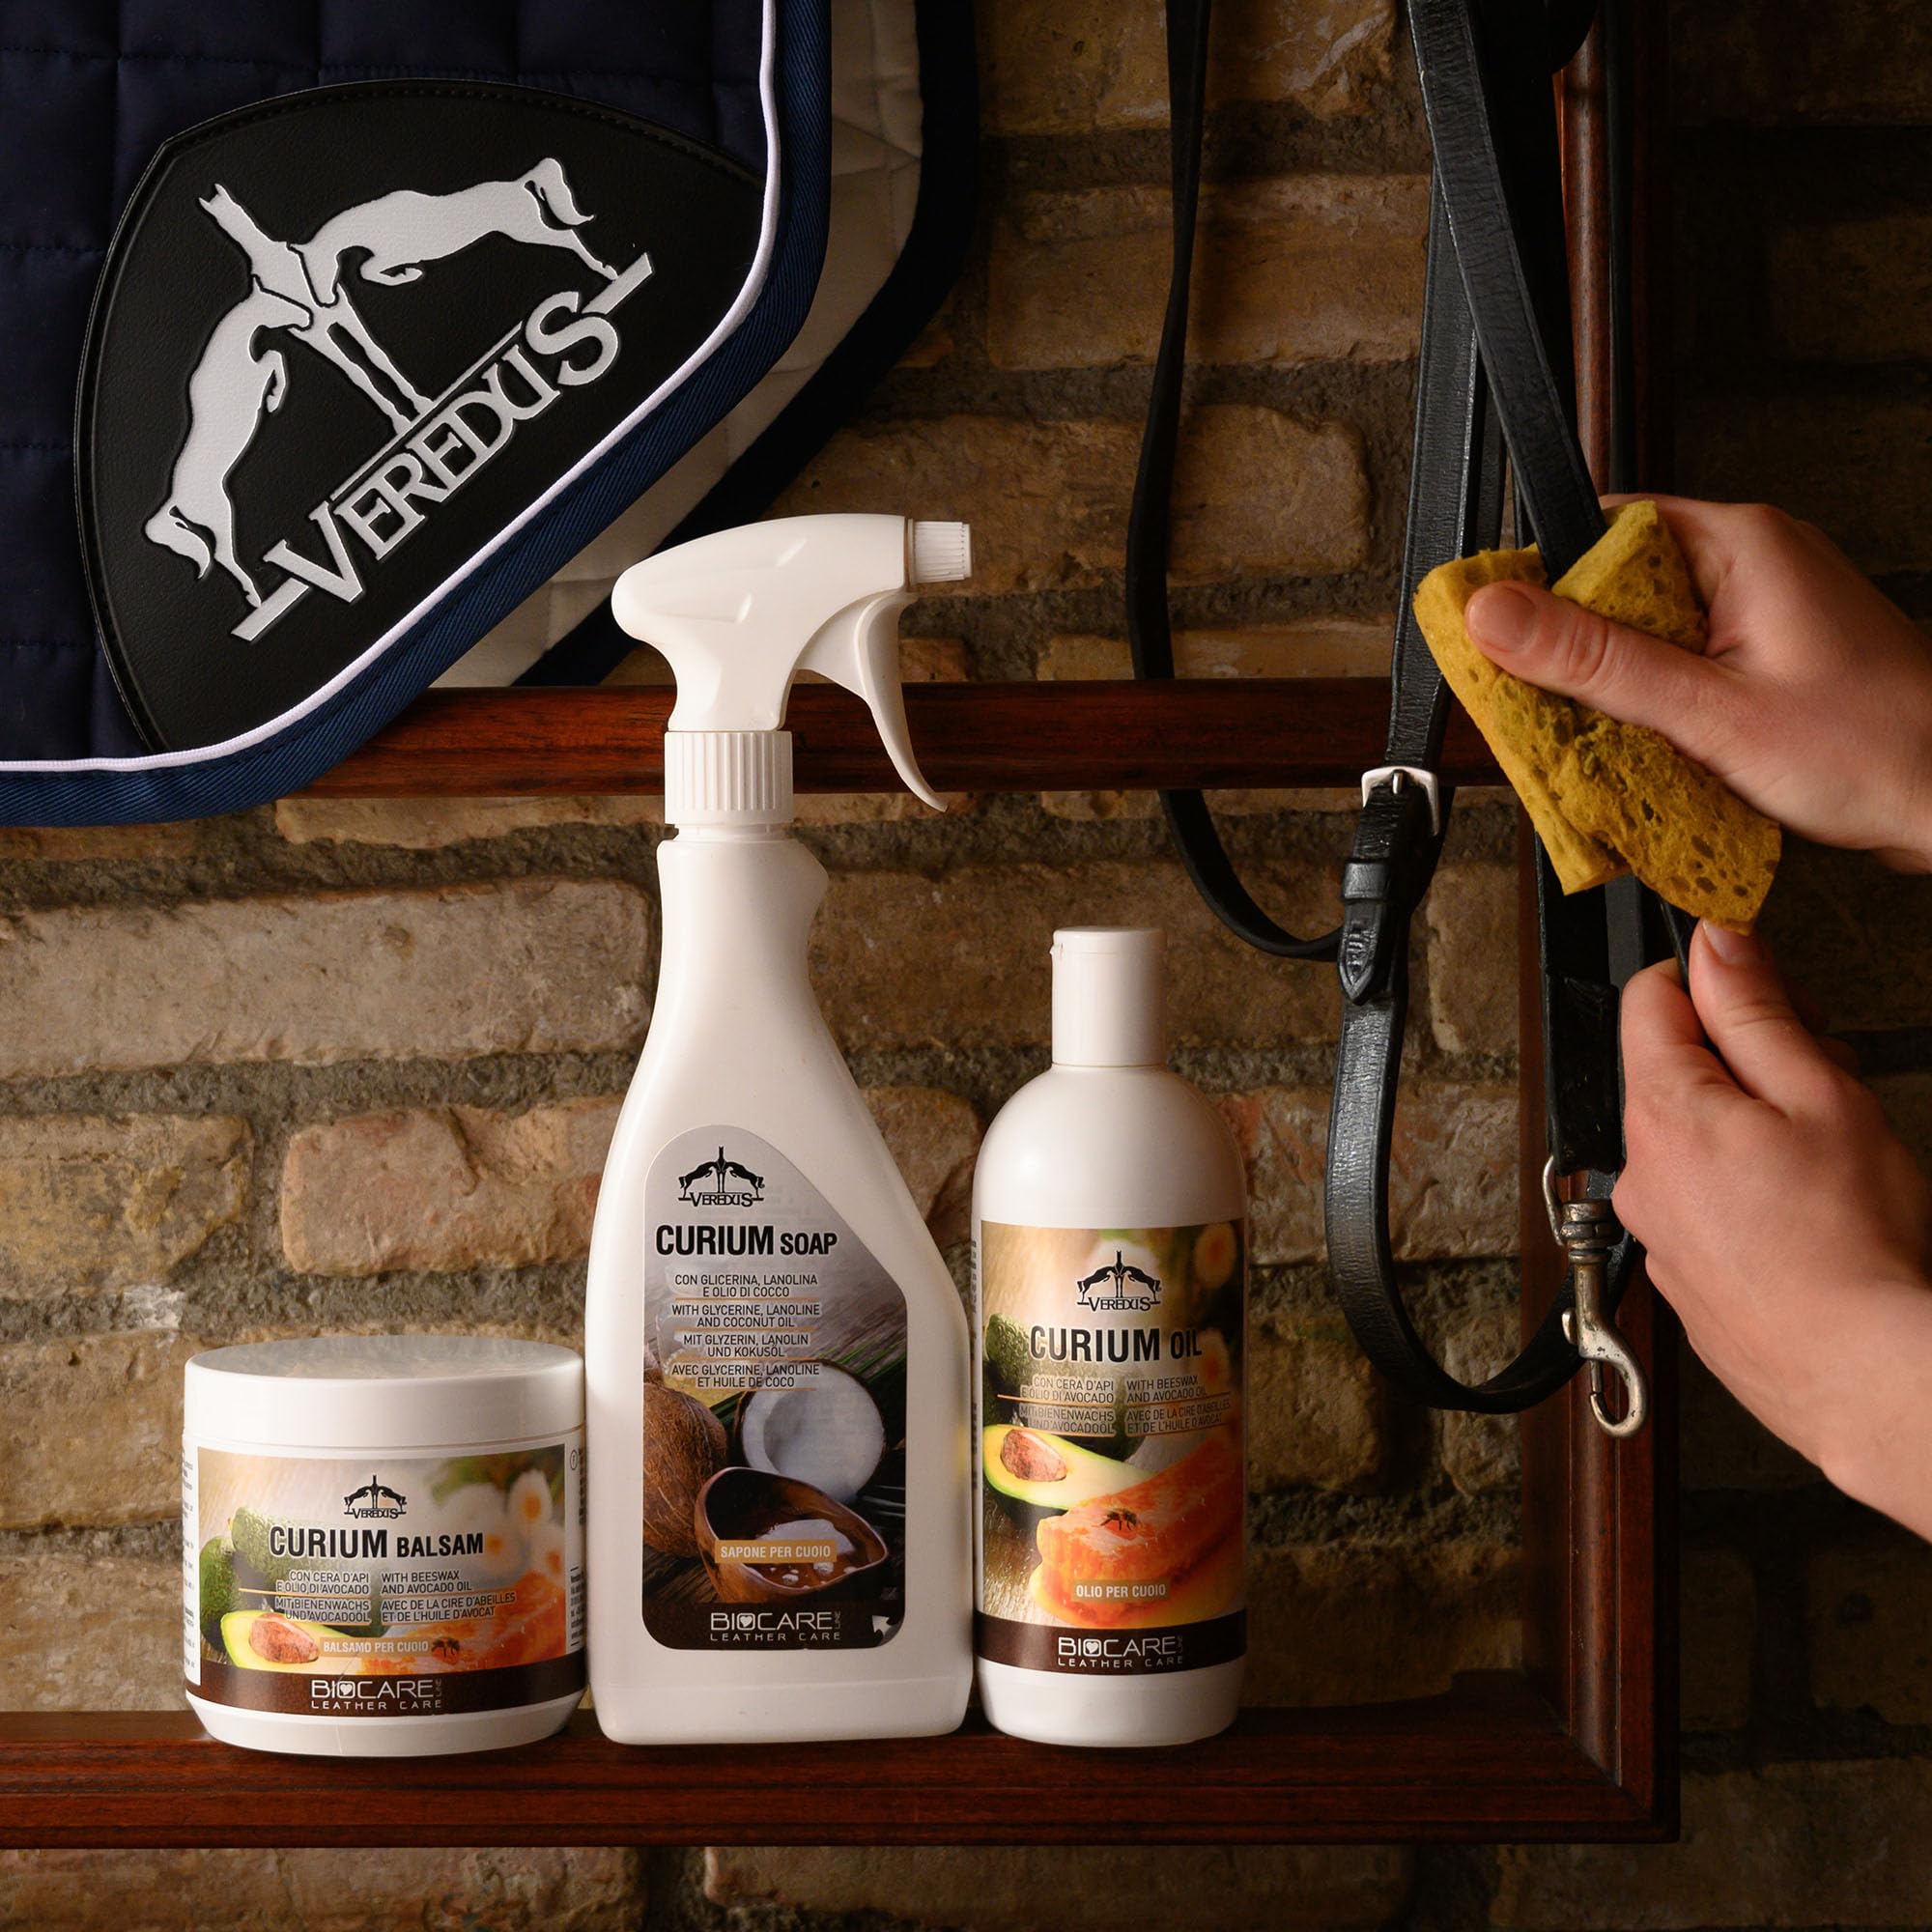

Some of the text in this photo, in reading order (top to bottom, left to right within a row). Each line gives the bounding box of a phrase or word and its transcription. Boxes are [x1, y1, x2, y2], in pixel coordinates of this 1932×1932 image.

[263, 291, 619, 604] VEREDUS
[690, 1191, 753, 1208] VEREDUS
[656, 1224, 838, 1256] CURIUM SOAP
[675, 1274, 818, 1287] CON GLICERINA, LANOLINA
[703, 1287, 790, 1297] E OLIO DI COCCO
[672, 1304, 820, 1317] WITH GLYCERINE, LANOLINE
[1088, 1296, 1151, 1312] VEREDUS
[697, 1317, 795, 1327] AND COCONUT OIL
[684, 1334, 809, 1347] MIT GLYZERIN, LANOLIN
[1030, 1325, 1203, 1362] CURIUM OIL
[707, 1347, 731, 1357] UND
[671, 1364, 820, 1377] AVEC GLYCERINE, LANOLINE
[697, 1377, 795, 1388] ET HUILE DE COCO
[1034, 1377, 1114, 1391] CON CERA D'API
[1126, 1375, 1198, 1391] WITH BEESWAX
[1029, 1387, 1051, 1400] OLIO
[1052, 1389, 1063, 1401] DI
[1064, 1391, 1114, 1404] AVOCADO
[1126, 1391, 1151, 1403] AND
[1152, 1388, 1194, 1402] AVOCADO
[1038, 1406, 1115, 1421] BIENENWACHS
[1126, 1409, 1151, 1421] AVEC
[1153, 1407, 1165, 1420] DE
[1167, 1407, 1178, 1419] LA
[1179, 1404, 1195, 1417] CIRE
[1127, 1421, 1140, 1434] ET
[1144, 1421, 1156, 1433] DE
[1159, 1417, 1190, 1432] L'HUILE
[352, 1508, 399, 1520] VEREDUS
[270, 1525, 483, 1558] CURIUM BALSAM
[721, 1546, 831, 1558] SAPONE PER CUOIO
[290, 1571, 369, 1583] CON CERA D'API
[382, 1570, 460, 1582] WITH BEESWAX
[277, 1581, 369, 1595] E OLIO DI AVOCADO
[382, 1581, 472, 1594] AND AVOCADO OIL
[1076, 1584, 1166, 1598] OLIO PER CUOIO
[275, 1598, 370, 1611] MIT BIENENWACHS
[382, 1592, 516, 1611] AVEC DE LA CIRE D'ABEILLES
[286, 1610, 307, 1620] UND
[383, 1606, 496, 1623] ET DE L'HUILE D'AVOCAT
[710, 1612, 833, 1631] BIOCARE
[710, 1632, 840, 1641] LEATHER CARE
[324, 1641, 429, 1653] BALSAMO PER CUOIO
[1058, 1636, 1178, 1657] BIOCARE
[1058, 1656, 1183, 1668] LEATHER CARE
[311, 1679, 434, 1699] BIOCARE
[311, 1699, 441, 1710] LEATHER CARE
